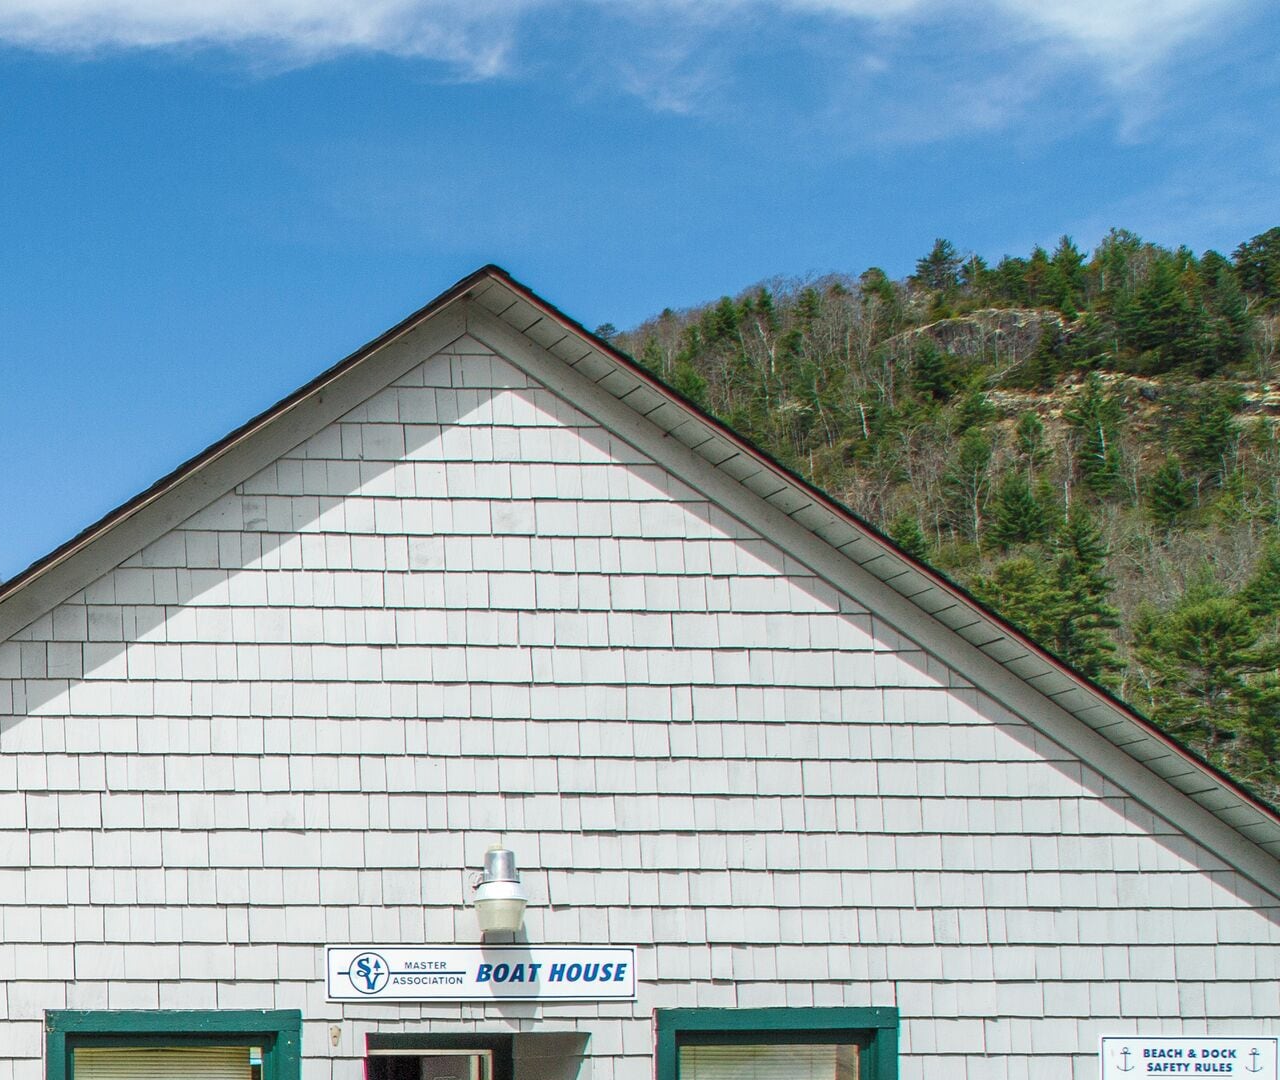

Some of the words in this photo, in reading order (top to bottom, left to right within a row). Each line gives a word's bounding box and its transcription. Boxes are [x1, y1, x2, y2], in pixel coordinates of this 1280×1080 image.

[404, 961, 447, 970] MASTER
[476, 963, 542, 983] BOAT
[549, 962, 627, 982] HOUSE
[392, 976, 464, 985] ASSOCIATION
[1143, 1048, 1184, 1059] BEACH
[1187, 1049, 1198, 1059] &
[1201, 1049, 1237, 1059] DOCK
[1146, 1062, 1191, 1073] SAFETY
[1194, 1062, 1233, 1073] RULES
